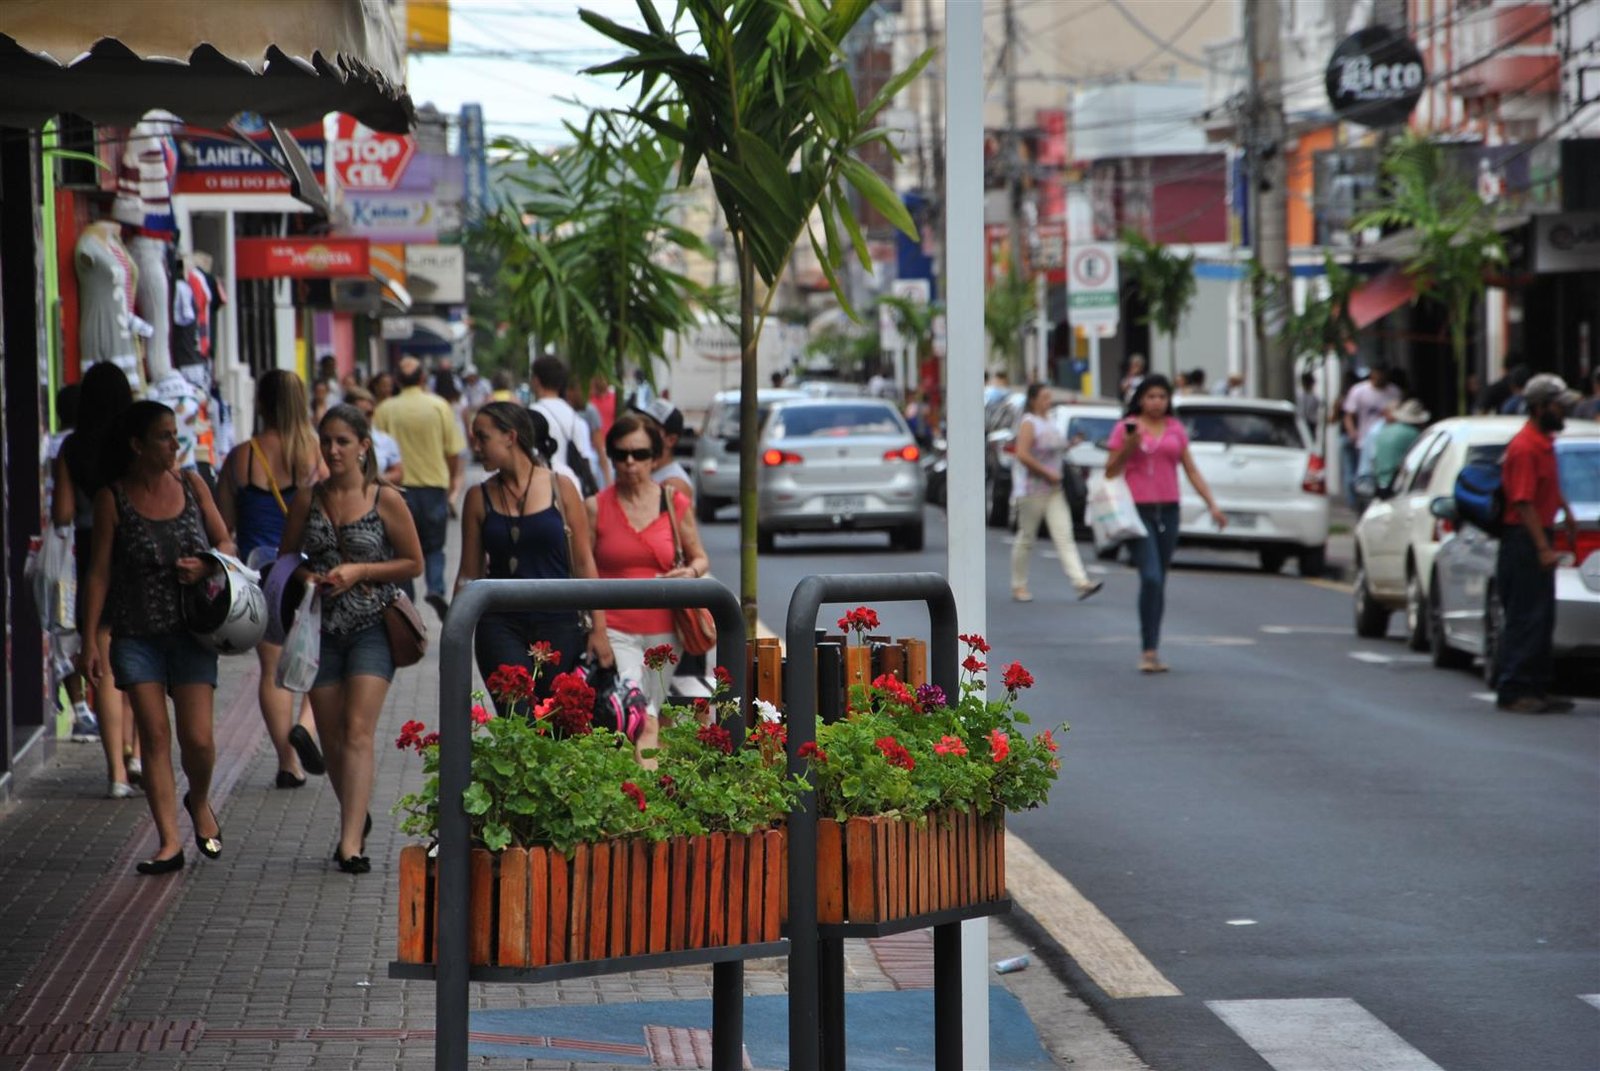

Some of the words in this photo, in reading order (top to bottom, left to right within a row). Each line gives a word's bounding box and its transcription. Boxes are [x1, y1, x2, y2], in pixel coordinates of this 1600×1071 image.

[186, 145, 264, 168] LANETA
[332, 137, 401, 163] STOP
[346, 163, 389, 187] CEL
